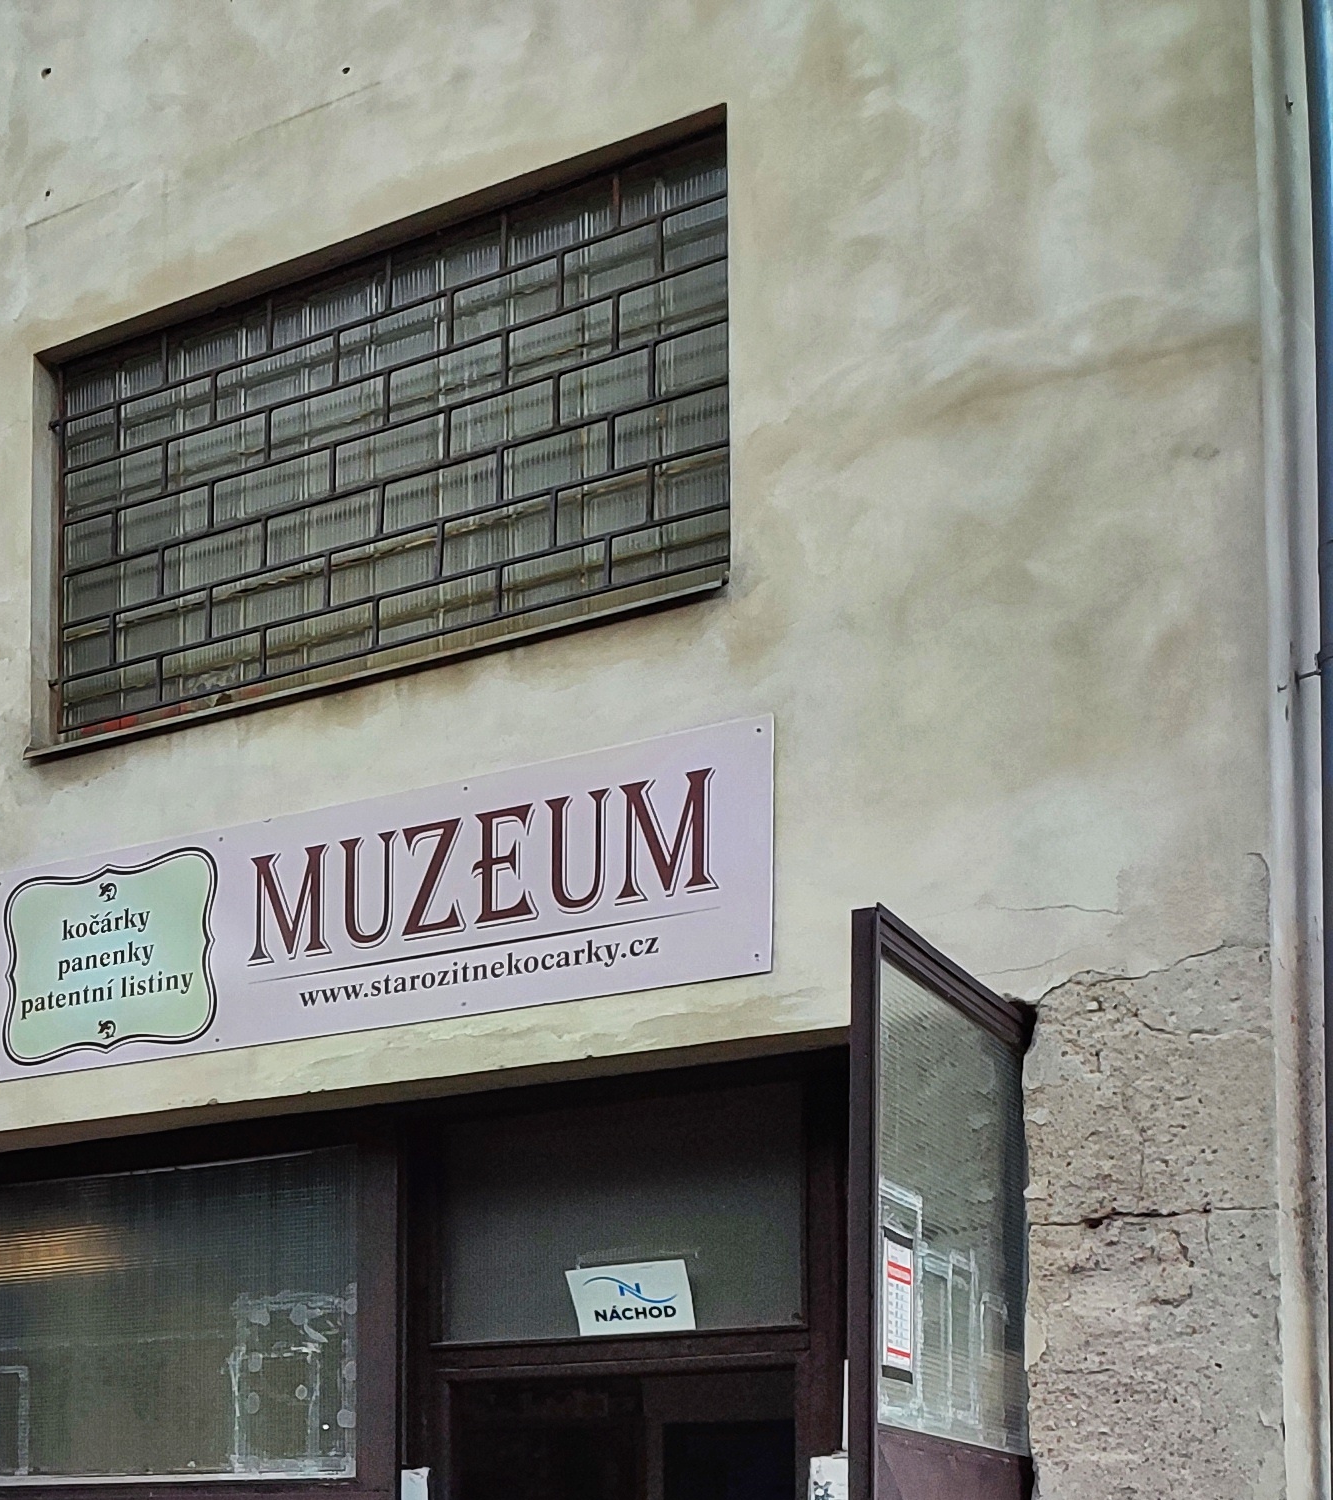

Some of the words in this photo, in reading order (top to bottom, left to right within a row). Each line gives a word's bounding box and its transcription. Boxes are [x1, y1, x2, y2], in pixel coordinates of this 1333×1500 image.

[247, 767, 718, 966] MUZEUM
[61, 907, 151, 941] kočárky
[57, 941, 155, 981] panenky
[299, 936, 660, 1007] www.starozitnekocarky.cz
[20, 979, 115, 1020] patentní
[120, 971, 194, 999] listiny
[594, 1305, 677, 1322] NÁCHOD
